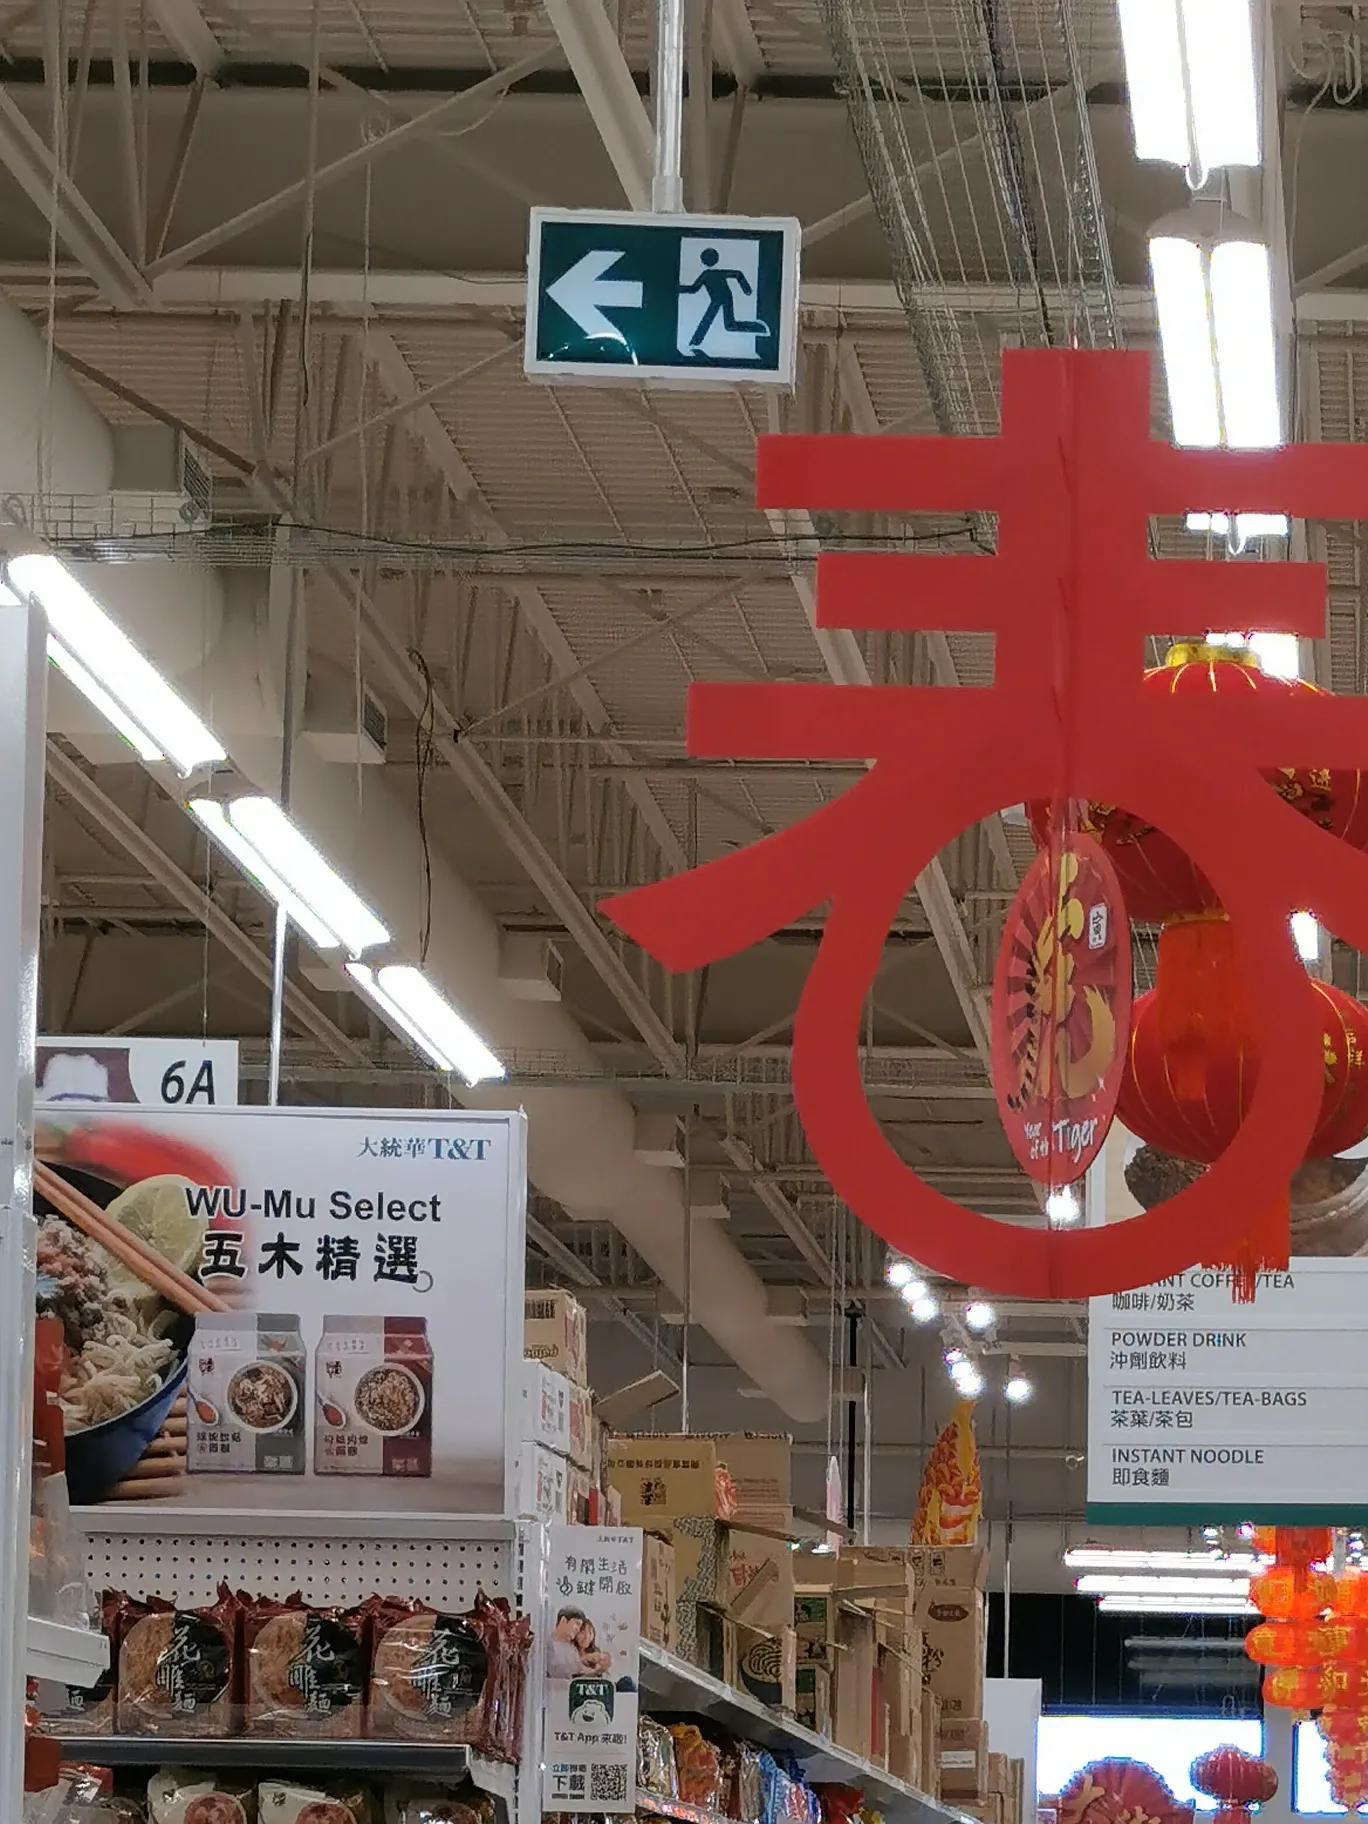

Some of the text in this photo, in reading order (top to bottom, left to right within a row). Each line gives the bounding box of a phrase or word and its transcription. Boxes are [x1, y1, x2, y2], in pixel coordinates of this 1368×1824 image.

[160, 1059, 216, 1105] 6A
[1053, 1118, 1099, 1163] Tiger
[185, 1187, 442, 1222] WU-Mu Select
[200, 1231, 420, 1285] 五木精選
[1190, 1273, 1295, 1289] COFF/TEA
[1111, 1292, 1195, 1312] 咖啡/奶茶
[1111, 1332, 1247, 1348] POWDER DRINK
[1109, 1350, 1187, 1370] 沖劑飲料
[1112, 1390, 1308, 1406] TEA-LEAVES/TEA-BAGS
[1110, 1409, 1194, 1429] 茶葉/茶包
[1112, 1449, 1265, 1464] INSTANT NOODLE
[1111, 1468, 1170, 1486] 即食麵
[575, 1683, 609, 1697] T&T
[554, 1732, 575, 1742] T&T
[577, 1732, 599, 1745] App
[552, 1775, 586, 1792] 下載
